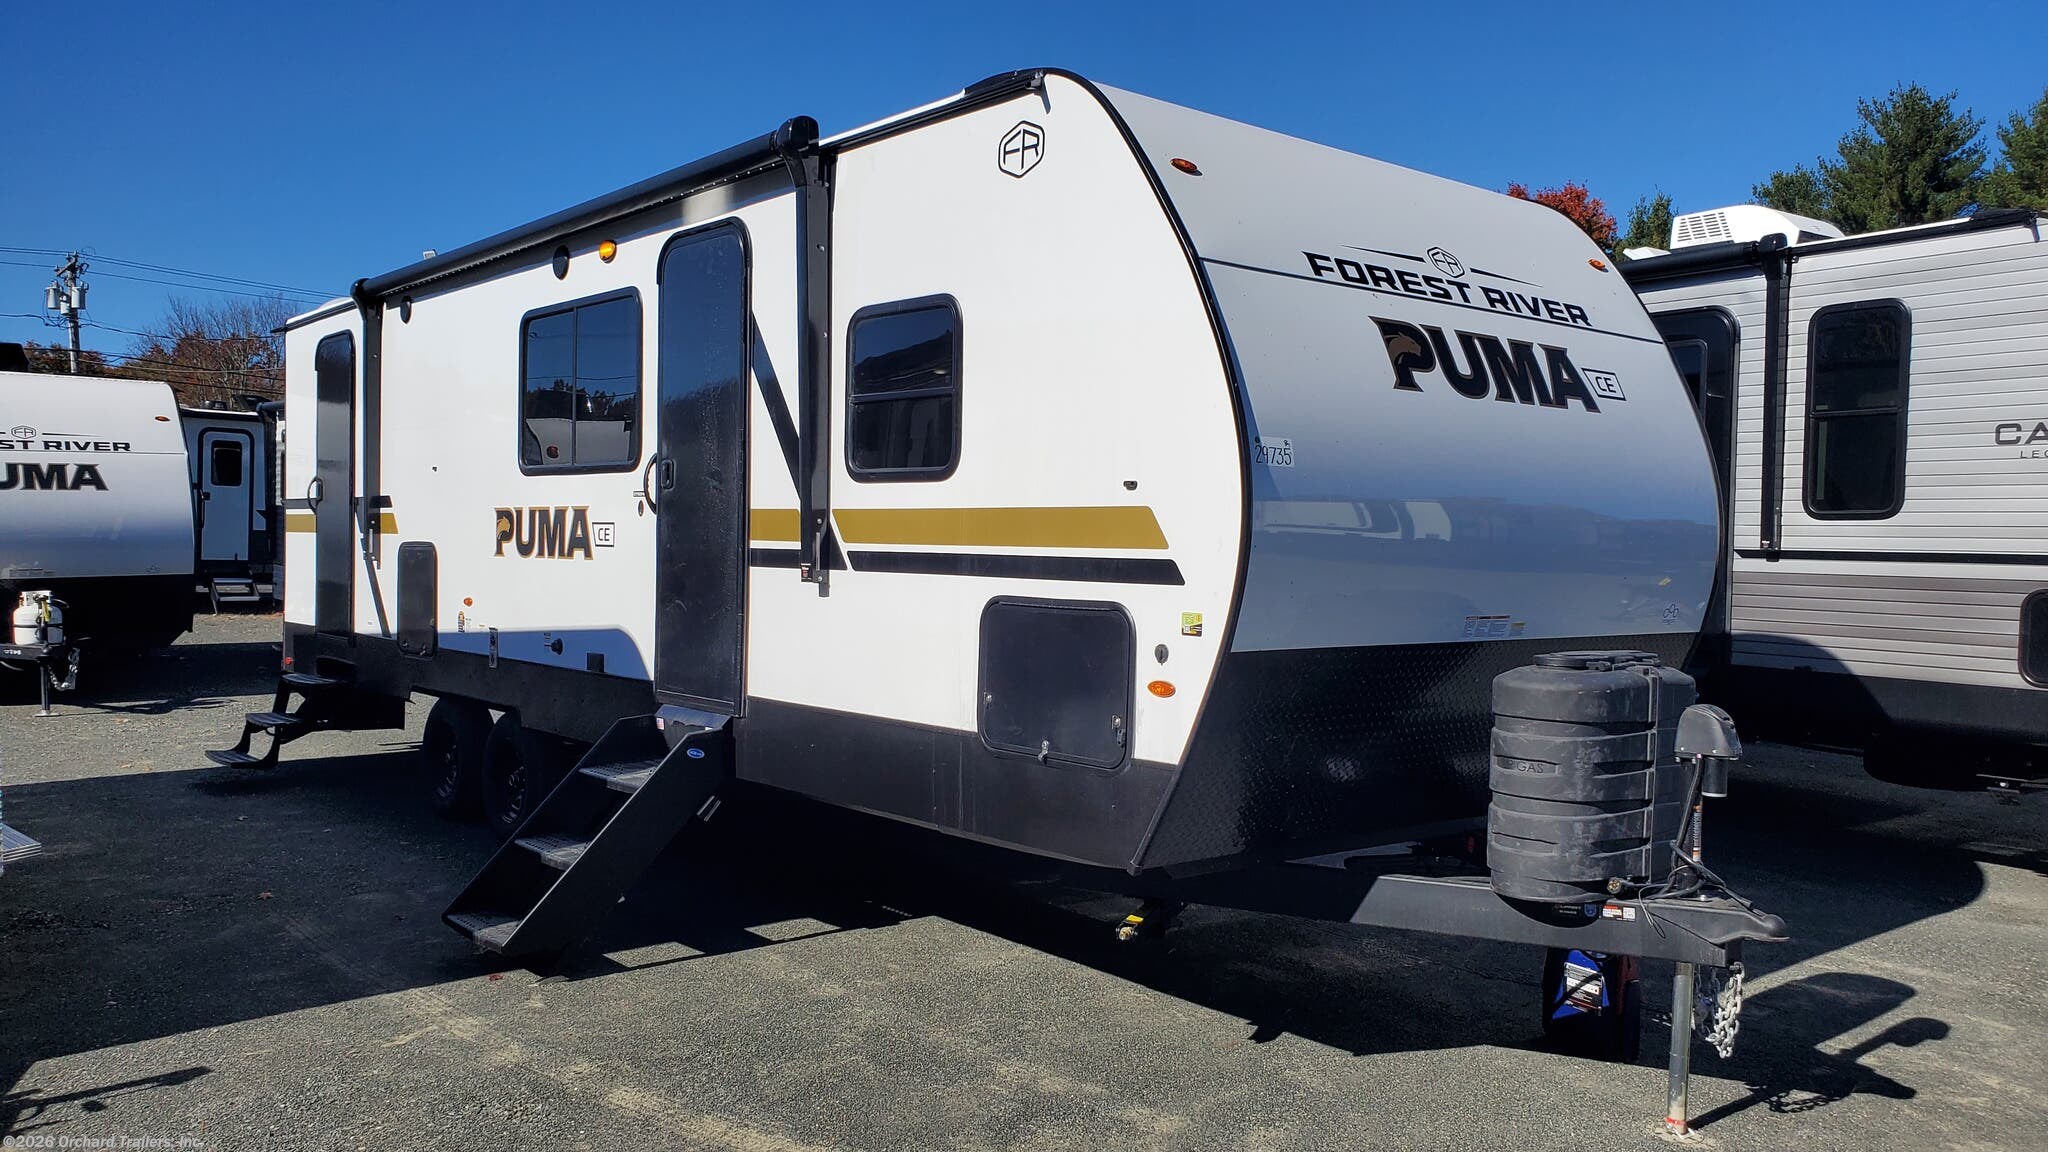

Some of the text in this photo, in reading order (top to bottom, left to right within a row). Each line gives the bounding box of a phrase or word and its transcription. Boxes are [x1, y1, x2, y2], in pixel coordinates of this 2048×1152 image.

[1301, 251, 1593, 327] FOREST RIVER
[1368, 315, 1602, 414] PUMA
[1995, 421, 2048, 445] CA
[42, 440, 132, 451] RIVER
[1254, 444, 1292, 466] 29735
[493, 505, 593, 560] PUMA
[1516, 761, 1545, 774] GAS
